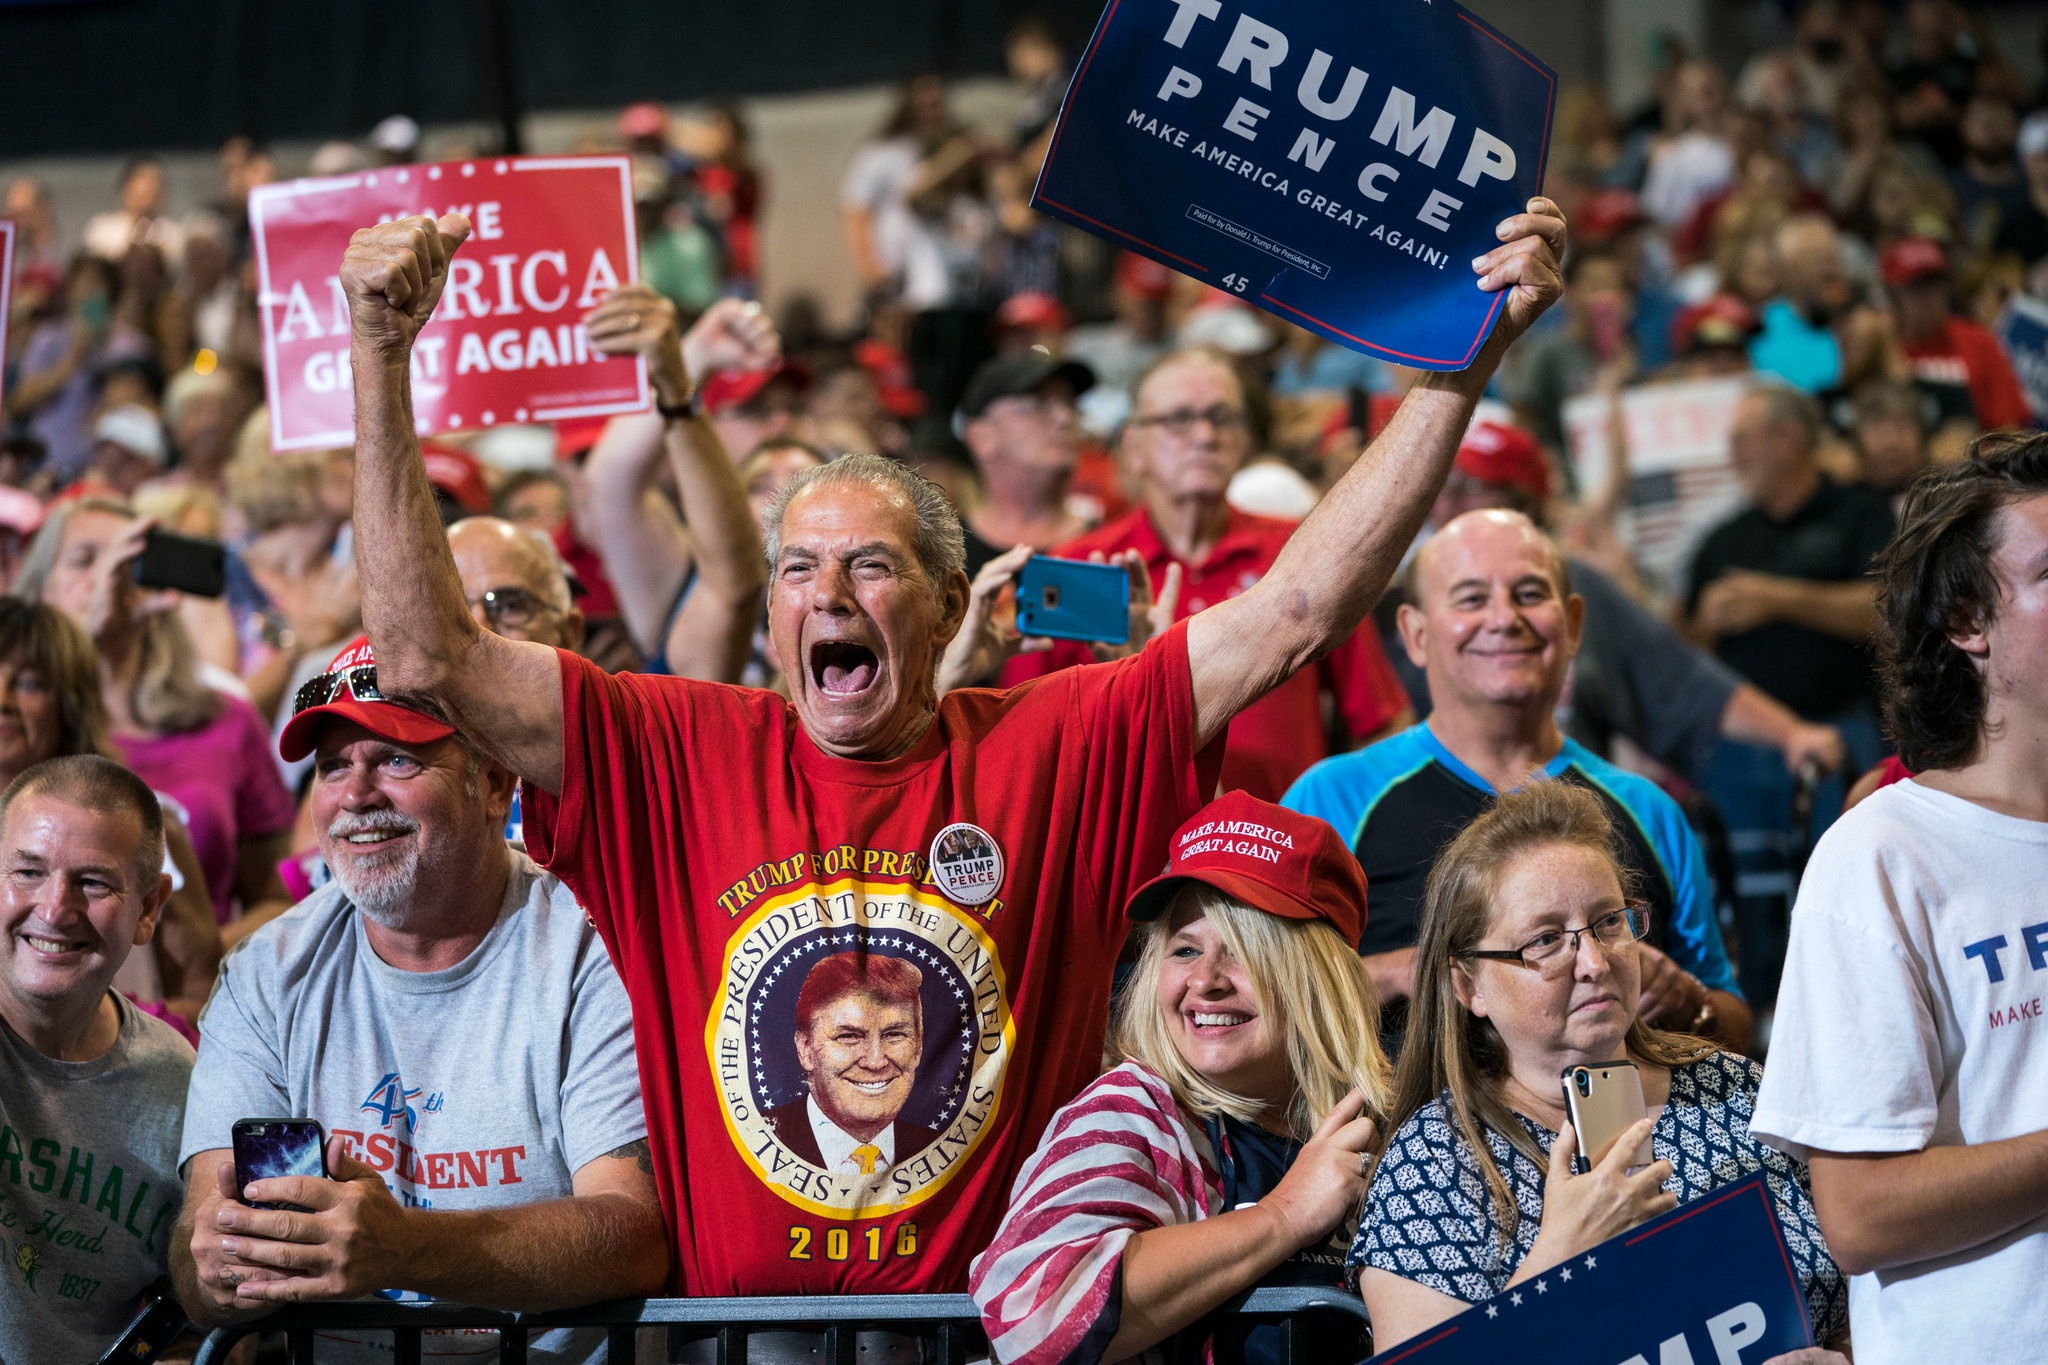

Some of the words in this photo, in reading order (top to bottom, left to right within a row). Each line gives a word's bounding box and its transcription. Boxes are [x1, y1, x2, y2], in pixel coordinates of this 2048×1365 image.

[1163, 0, 1517, 187] TRUMP
[1157, 65, 1463, 232] PENCE
[1126, 109, 1190, 148] MAKE
[1192, 141, 1289, 196] AMERICA
[1297, 189, 1368, 230] GREAT
[1370, 224, 1449, 270] AGAIN!
[1193, 209, 1208, 221] Paid
[1207, 216, 1217, 225] for
[1216, 219, 1225, 229] by
[1224, 223, 1247, 239] Donald
[1252, 235, 1272, 250] Trump
[1271, 245, 1281, 254] for
[1281, 249, 1310, 268] President,
[1310, 262, 1322, 274] Inc.
[276, 246, 622, 344] ARICA
[1222, 273, 1249, 292] 45
[1179, 821, 1215, 847] MAKE
[1214, 821, 1294, 849] AMERICA
[1181, 839, 1223, 861] GREAT
[1222, 840, 1282, 864] AGAIN
[716, 851, 806, 919] TRUMP
[810, 845, 857, 876] FOR
[943, 859, 995, 877] TRUMP
[949, 871, 995, 887] PENCE
[863, 901, 893, 919] OF
[897, 902, 940, 932] THE
[724, 893, 855, 1026] PRESIDENT
[947, 923, 1001, 1055] UNITED
[1989, 998, 2043, 1029] MAKE
[721, 1038, 739, 1086] THE
[728, 1091, 749, 1121] OF
[892, 1085, 994, 1195] STATES
[753, 1129, 833, 1201] SEAL
[26, 1209, 108, 1254] Herd
[788, 1221, 919, 1262] 2016
[1301, 1251, 1346, 1266] AMER
[57, 1272, 100, 1300] 1837
